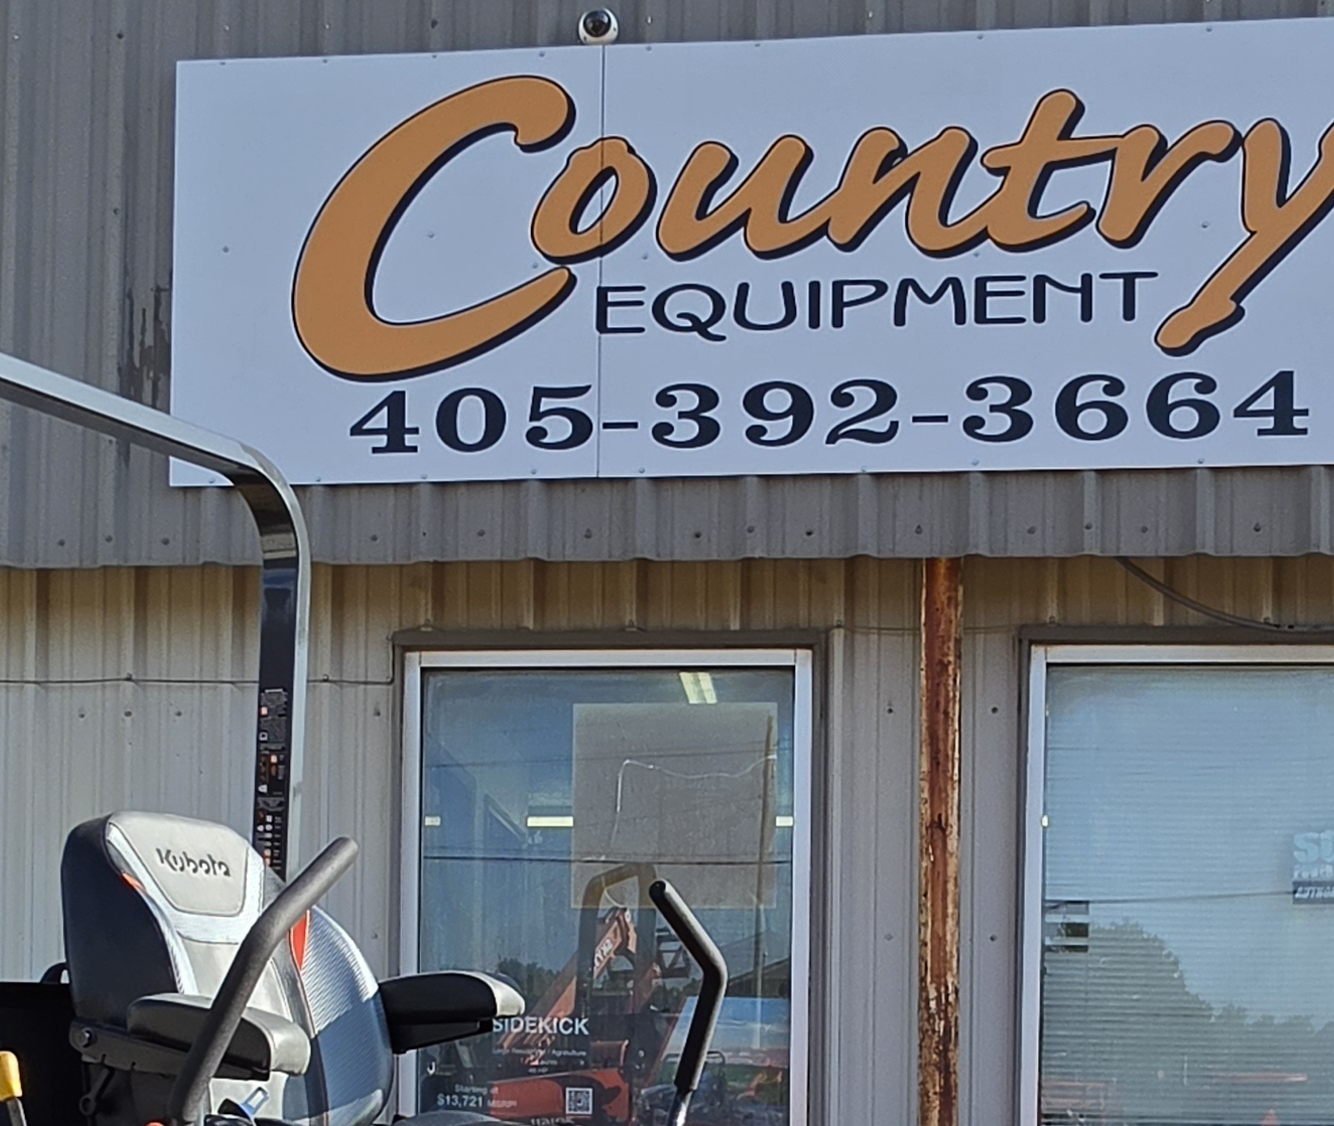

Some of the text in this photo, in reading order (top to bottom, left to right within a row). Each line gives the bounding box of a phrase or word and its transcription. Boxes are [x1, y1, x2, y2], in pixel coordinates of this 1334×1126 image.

[595, 270, 1159, 340] EQUIPMENT
[349, 367, 1310, 456] 405-392-3664
[156, 847, 231, 877] Kubota
[492, 1016, 589, 1036] SIDEKICK
[437, 1093, 483, 1108] $13,721
